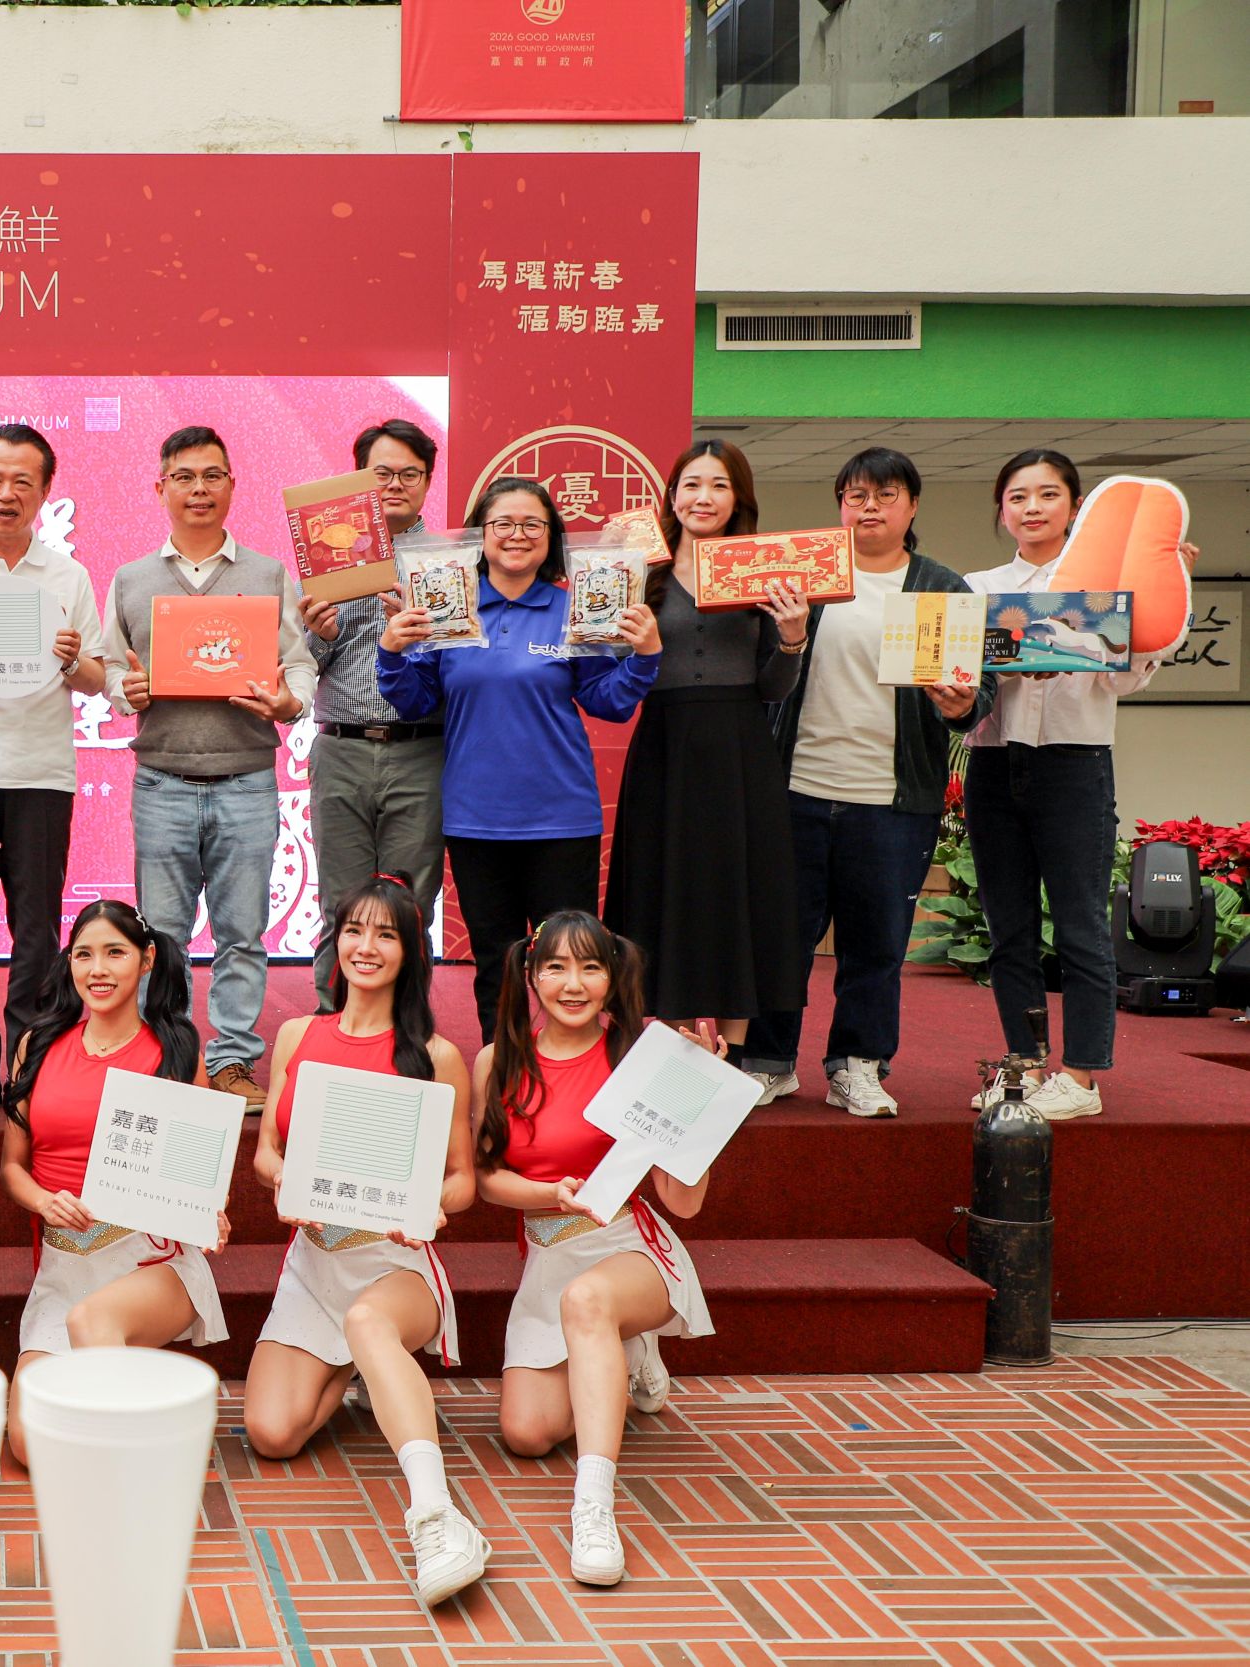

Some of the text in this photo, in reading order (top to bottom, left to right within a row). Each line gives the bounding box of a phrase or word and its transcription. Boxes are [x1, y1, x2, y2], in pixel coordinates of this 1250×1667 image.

[490, 32, 595, 42] 2026 GOOD HARVEST
[490, 56, 593, 67] 嘉義縣政府
[478, 260, 623, 292] 馬躍新春
[517, 303, 664, 334] 福駒臨嘉
[288, 509, 300, 539] Taro
[370, 491, 390, 559] Sweet Potato
[111, 1109, 159, 1136] 嘉義
[624, 1110, 679, 1149] CHIAYUM
[631, 1100, 686, 1137] 嘉義優鮮
[106, 1131, 154, 1158] 優鮮
[103, 1156, 150, 1175] CHIAYUM
[99, 1179, 212, 1214] Chiayi County Select
[309, 1198, 357, 1215] CHIAYUM
[312, 1177, 408, 1208] 嘉義優鮮
